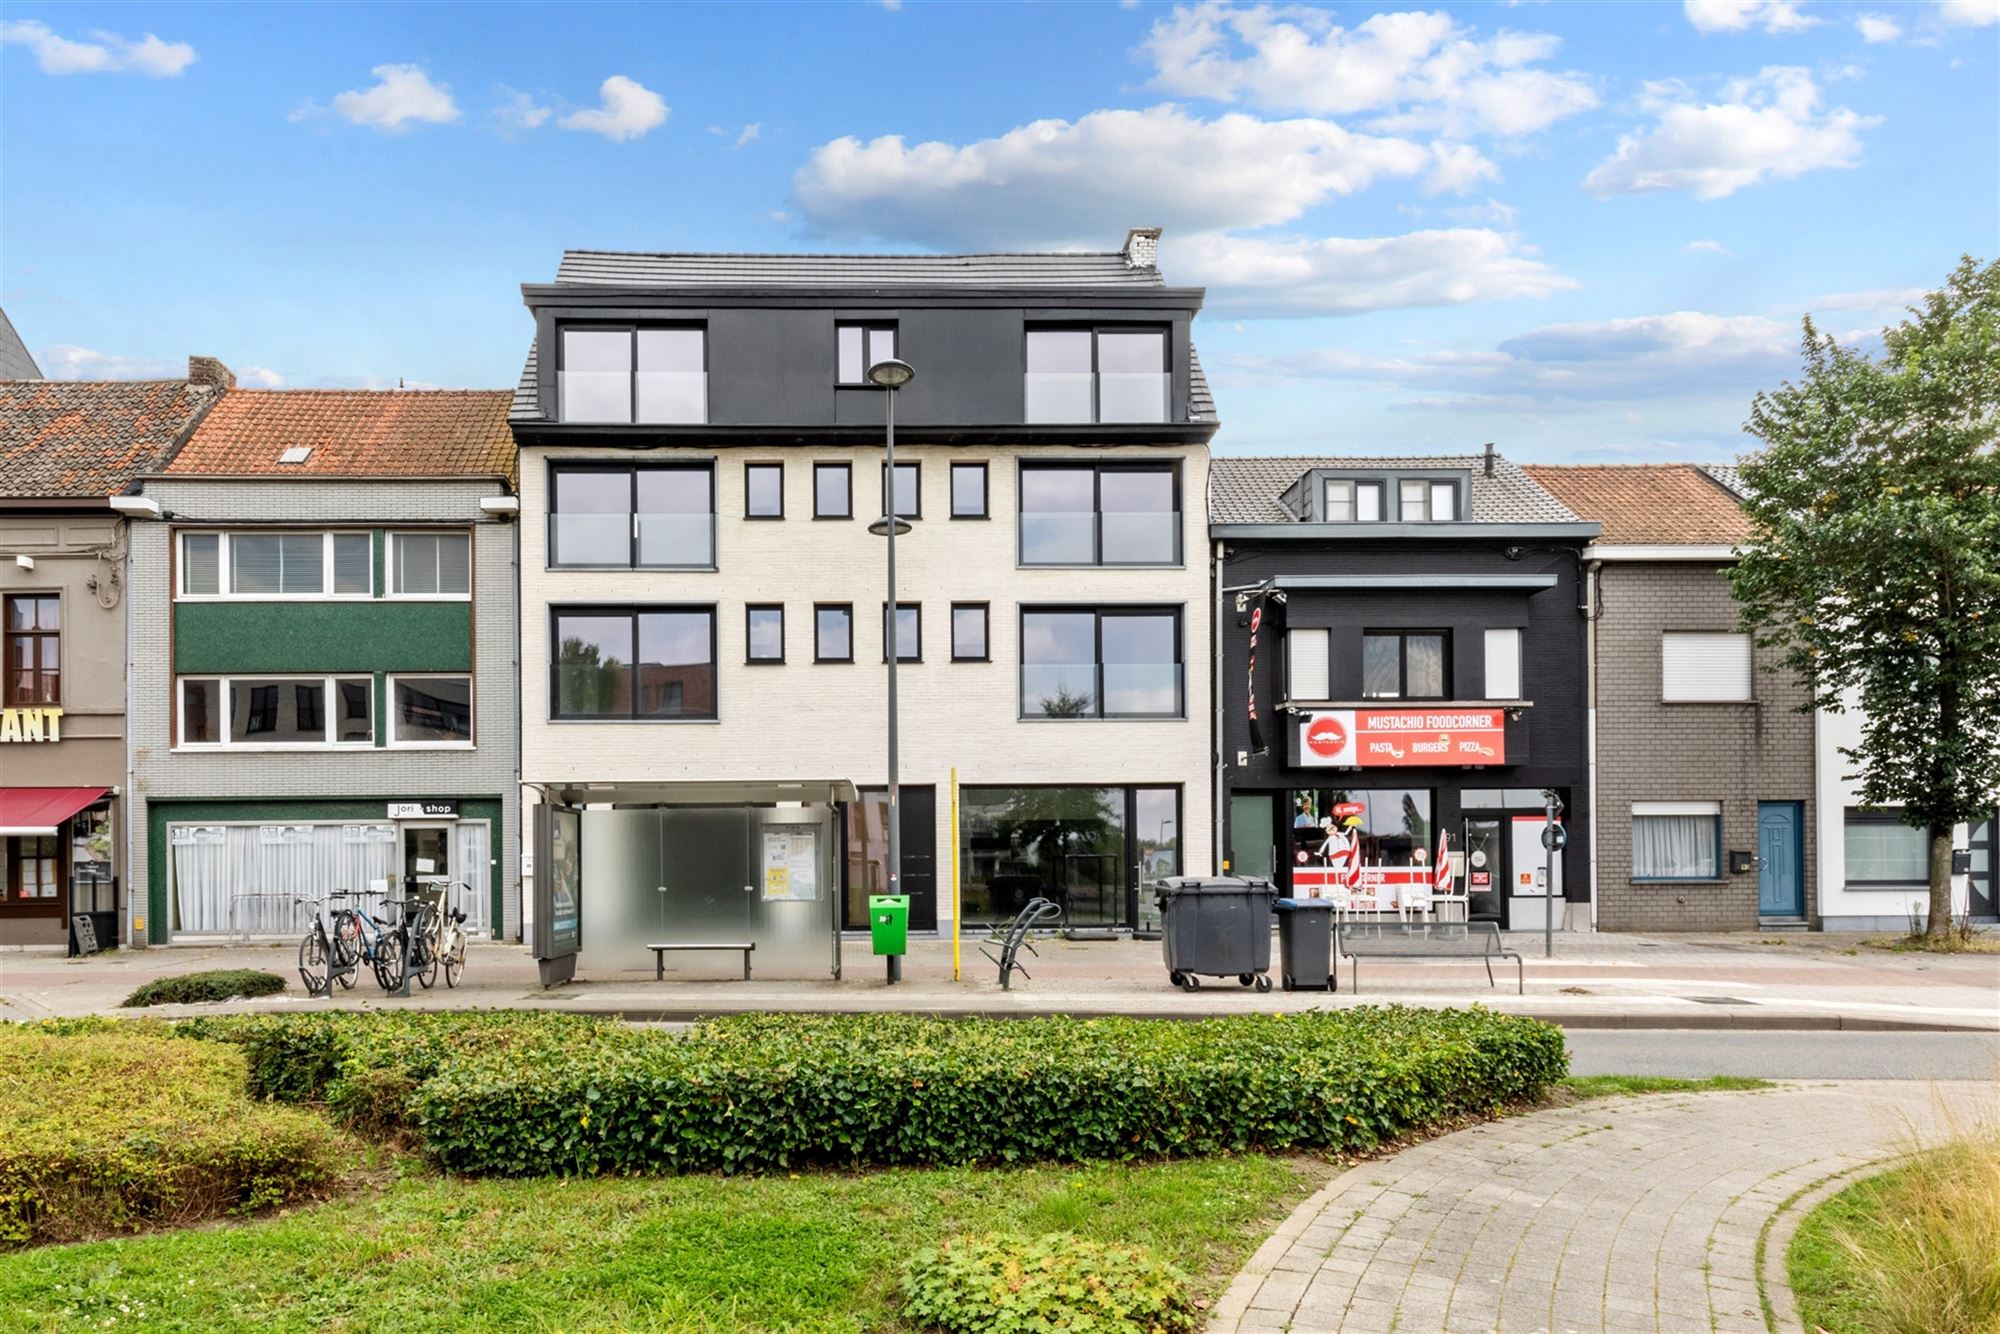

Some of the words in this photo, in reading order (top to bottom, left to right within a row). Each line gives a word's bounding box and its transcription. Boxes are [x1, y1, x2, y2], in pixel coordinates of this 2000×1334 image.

[0, 708, 64, 742] ANT
[1367, 715, 1424, 729] MUSTACHIO
[1426, 714, 1492, 729] FOODCORNER
[1369, 742, 1393, 753] PASTA
[1412, 742, 1449, 753] BURGERS
[1459, 741, 1480, 752] PIZZA
[426, 804, 451, 814] shop
